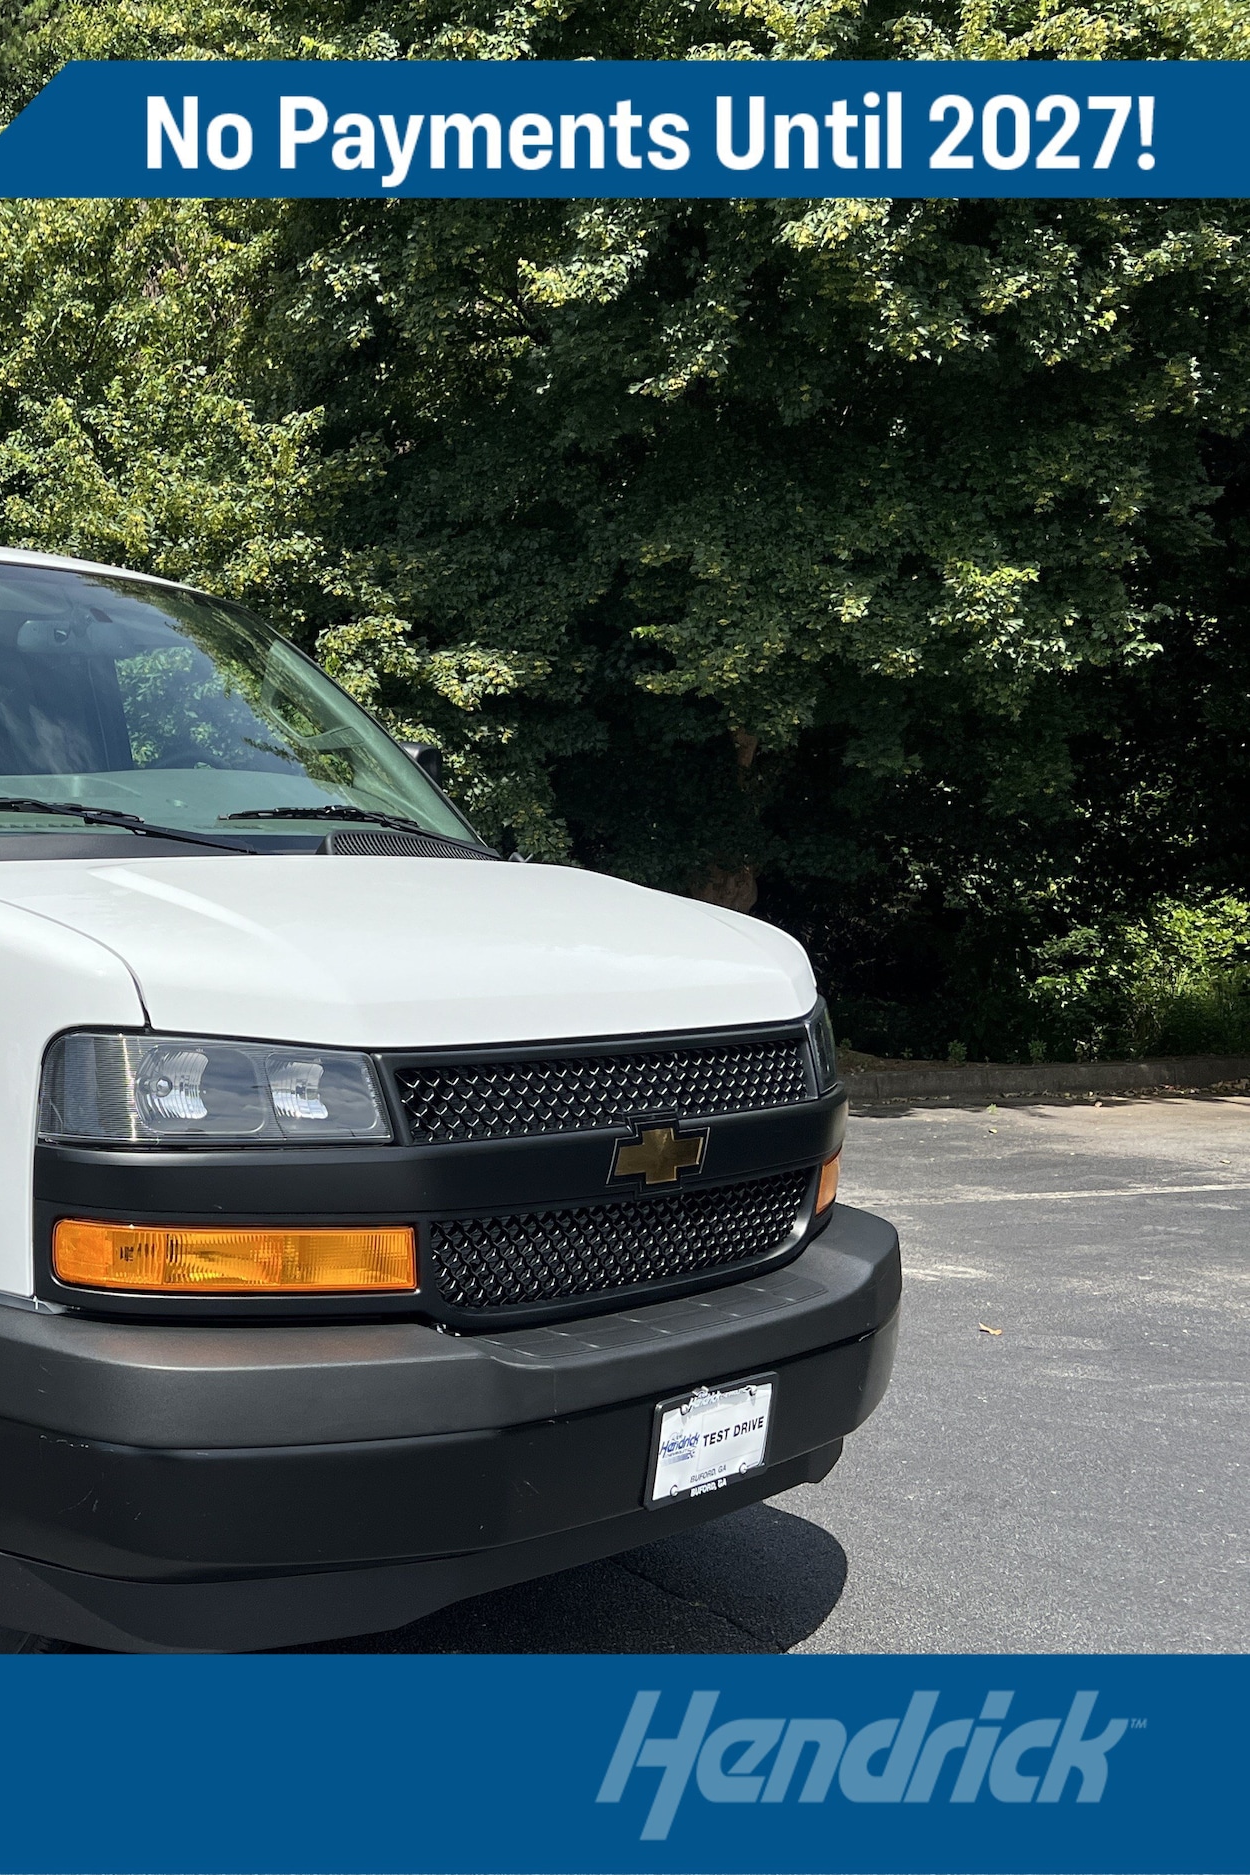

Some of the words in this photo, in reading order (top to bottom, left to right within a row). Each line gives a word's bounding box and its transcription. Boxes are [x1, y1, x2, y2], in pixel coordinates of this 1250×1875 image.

[703, 1428, 730, 1447] TEST
[733, 1416, 764, 1437] DRIVE
[659, 1432, 700, 1458] Hendrick
[690, 1468, 717, 1483] BUFORD,
[718, 1464, 727, 1474] GA
[690, 1481, 717, 1497] BUFORD,
[718, 1477, 727, 1488] GA
